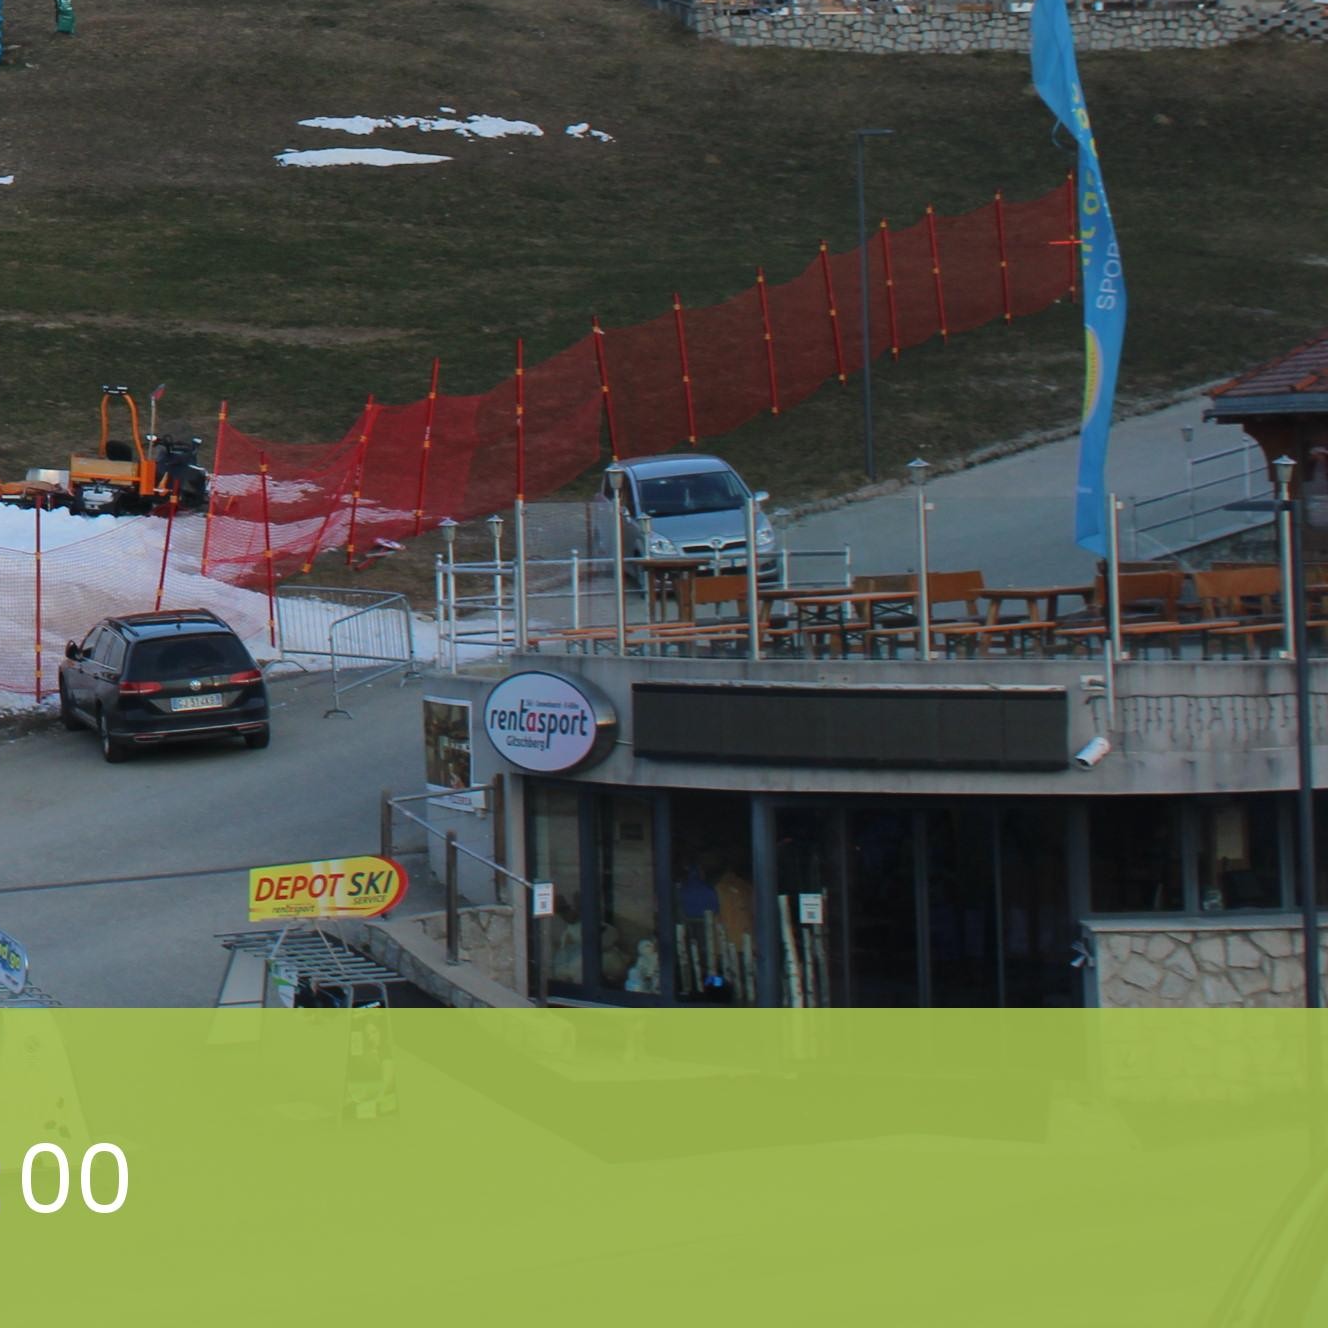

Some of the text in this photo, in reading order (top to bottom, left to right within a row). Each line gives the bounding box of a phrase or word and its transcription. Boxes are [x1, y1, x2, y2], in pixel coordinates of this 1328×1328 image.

[490, 698, 588, 750] rentasport
[255, 870, 393, 902] DEPOT SKI
[352, 893, 387, 906] SERVICE
[9, 951, 22, 970] go
